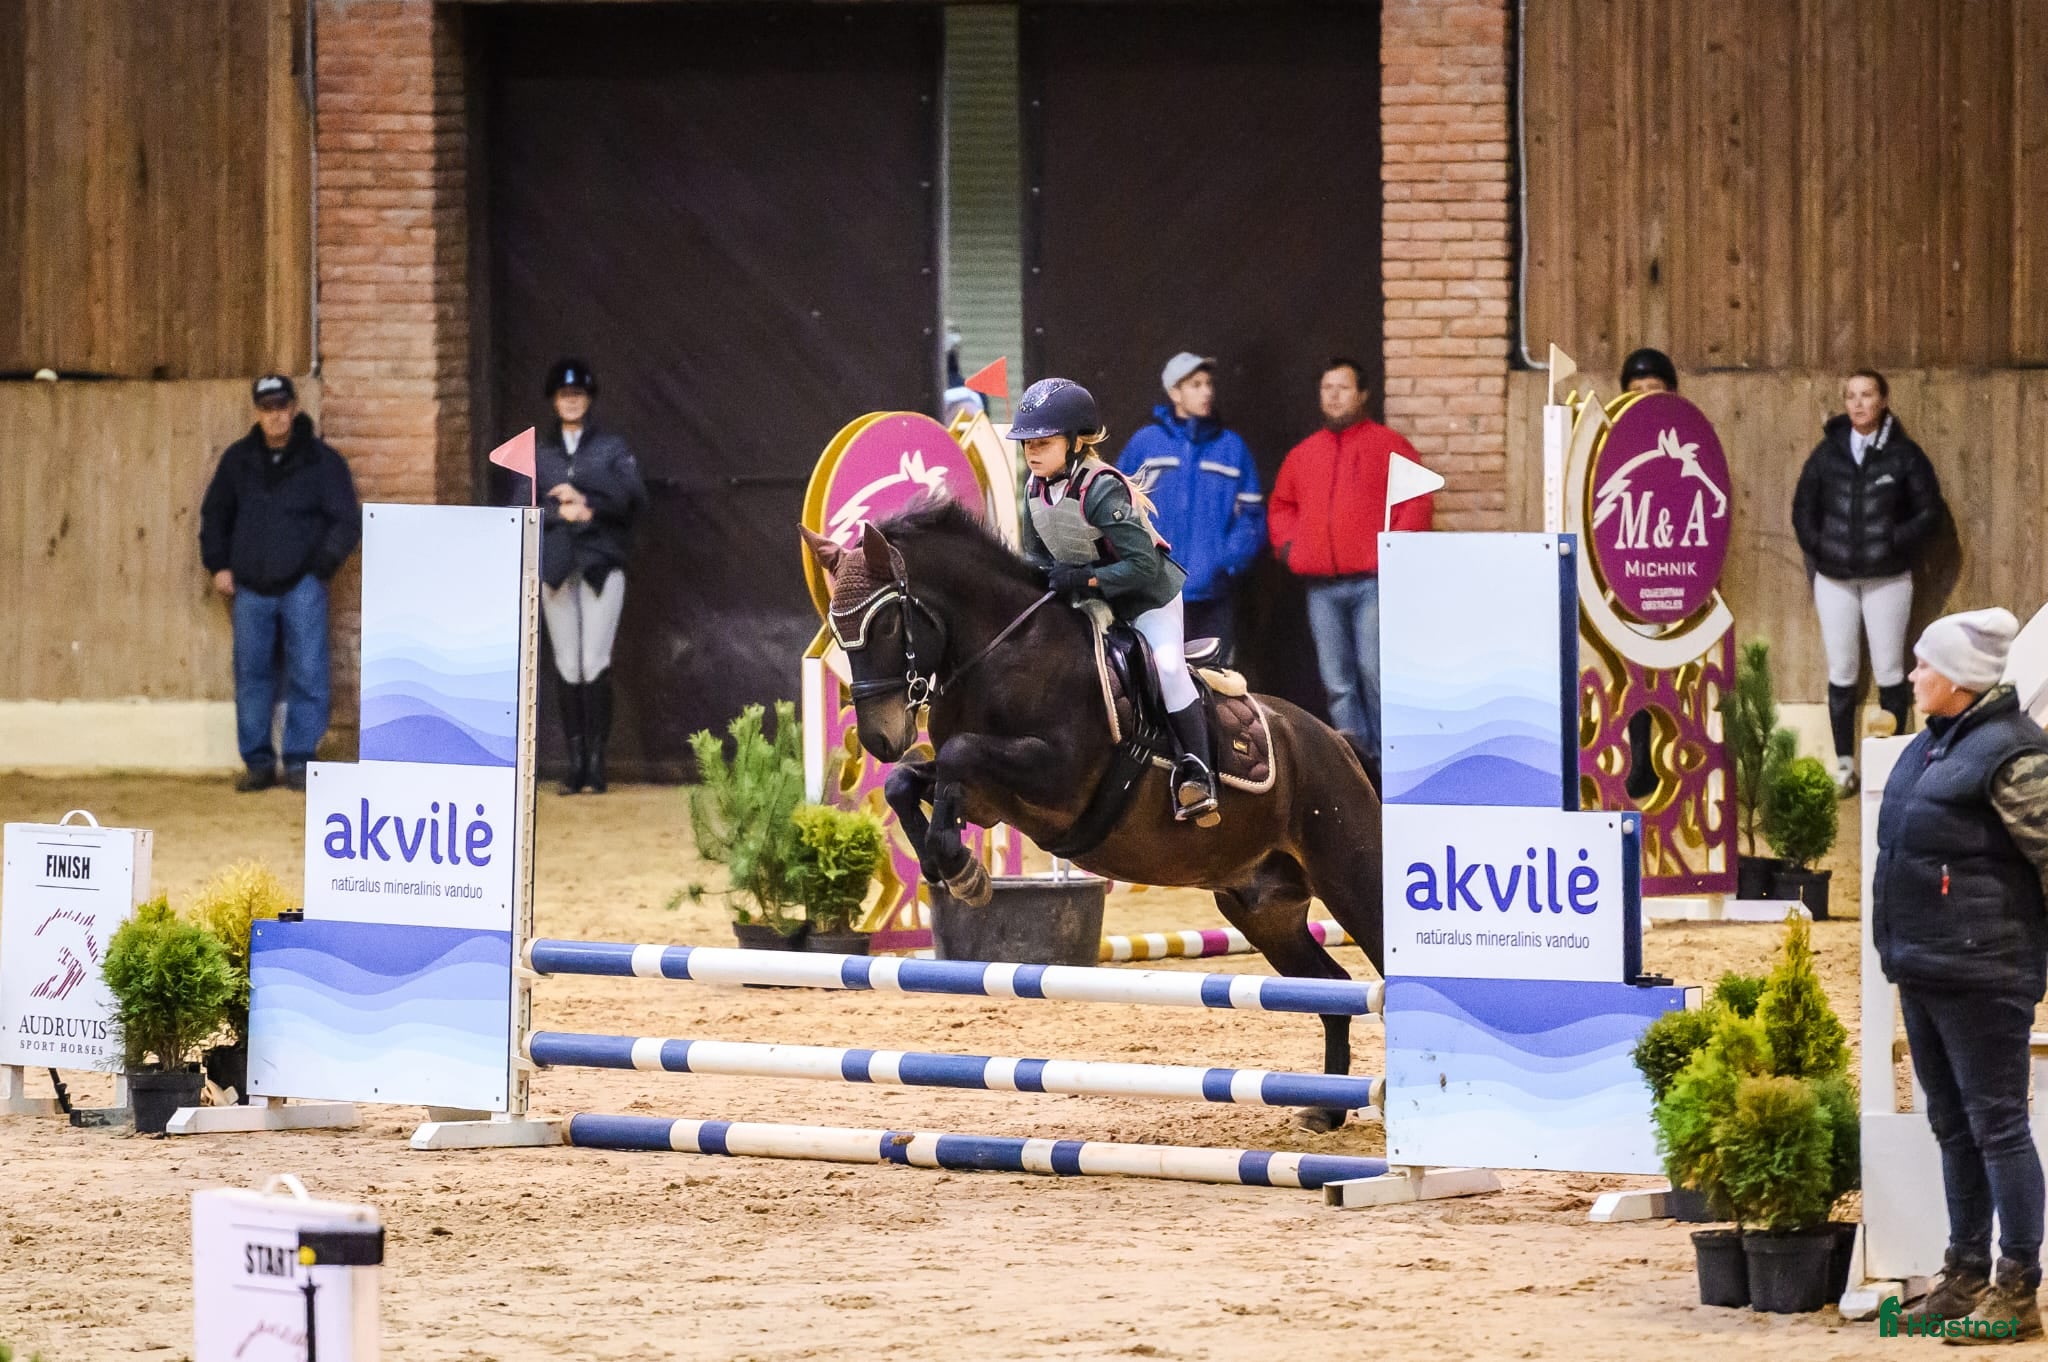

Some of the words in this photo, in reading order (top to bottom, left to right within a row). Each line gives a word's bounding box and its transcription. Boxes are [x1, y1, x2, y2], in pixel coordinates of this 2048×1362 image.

[1625, 560, 1698, 577] MICHNIK
[324, 797, 493, 867] akvilė
[46, 854, 91, 879] FINISH
[331, 876, 380, 893] natūralus
[383, 879, 441, 897] mineralinis
[444, 884, 483, 899] vanduo
[1405, 845, 1599, 915] akvilė
[1416, 929, 1472, 946] natūralus
[1476, 931, 1542, 948] mineralinis
[1545, 933, 1590, 949] vanduo
[19, 1014, 107, 1039] AUDRUVIS
[20, 1039, 55, 1052] SPORT
[60, 1042, 104, 1056] HORSES
[245, 1242, 299, 1278] START
